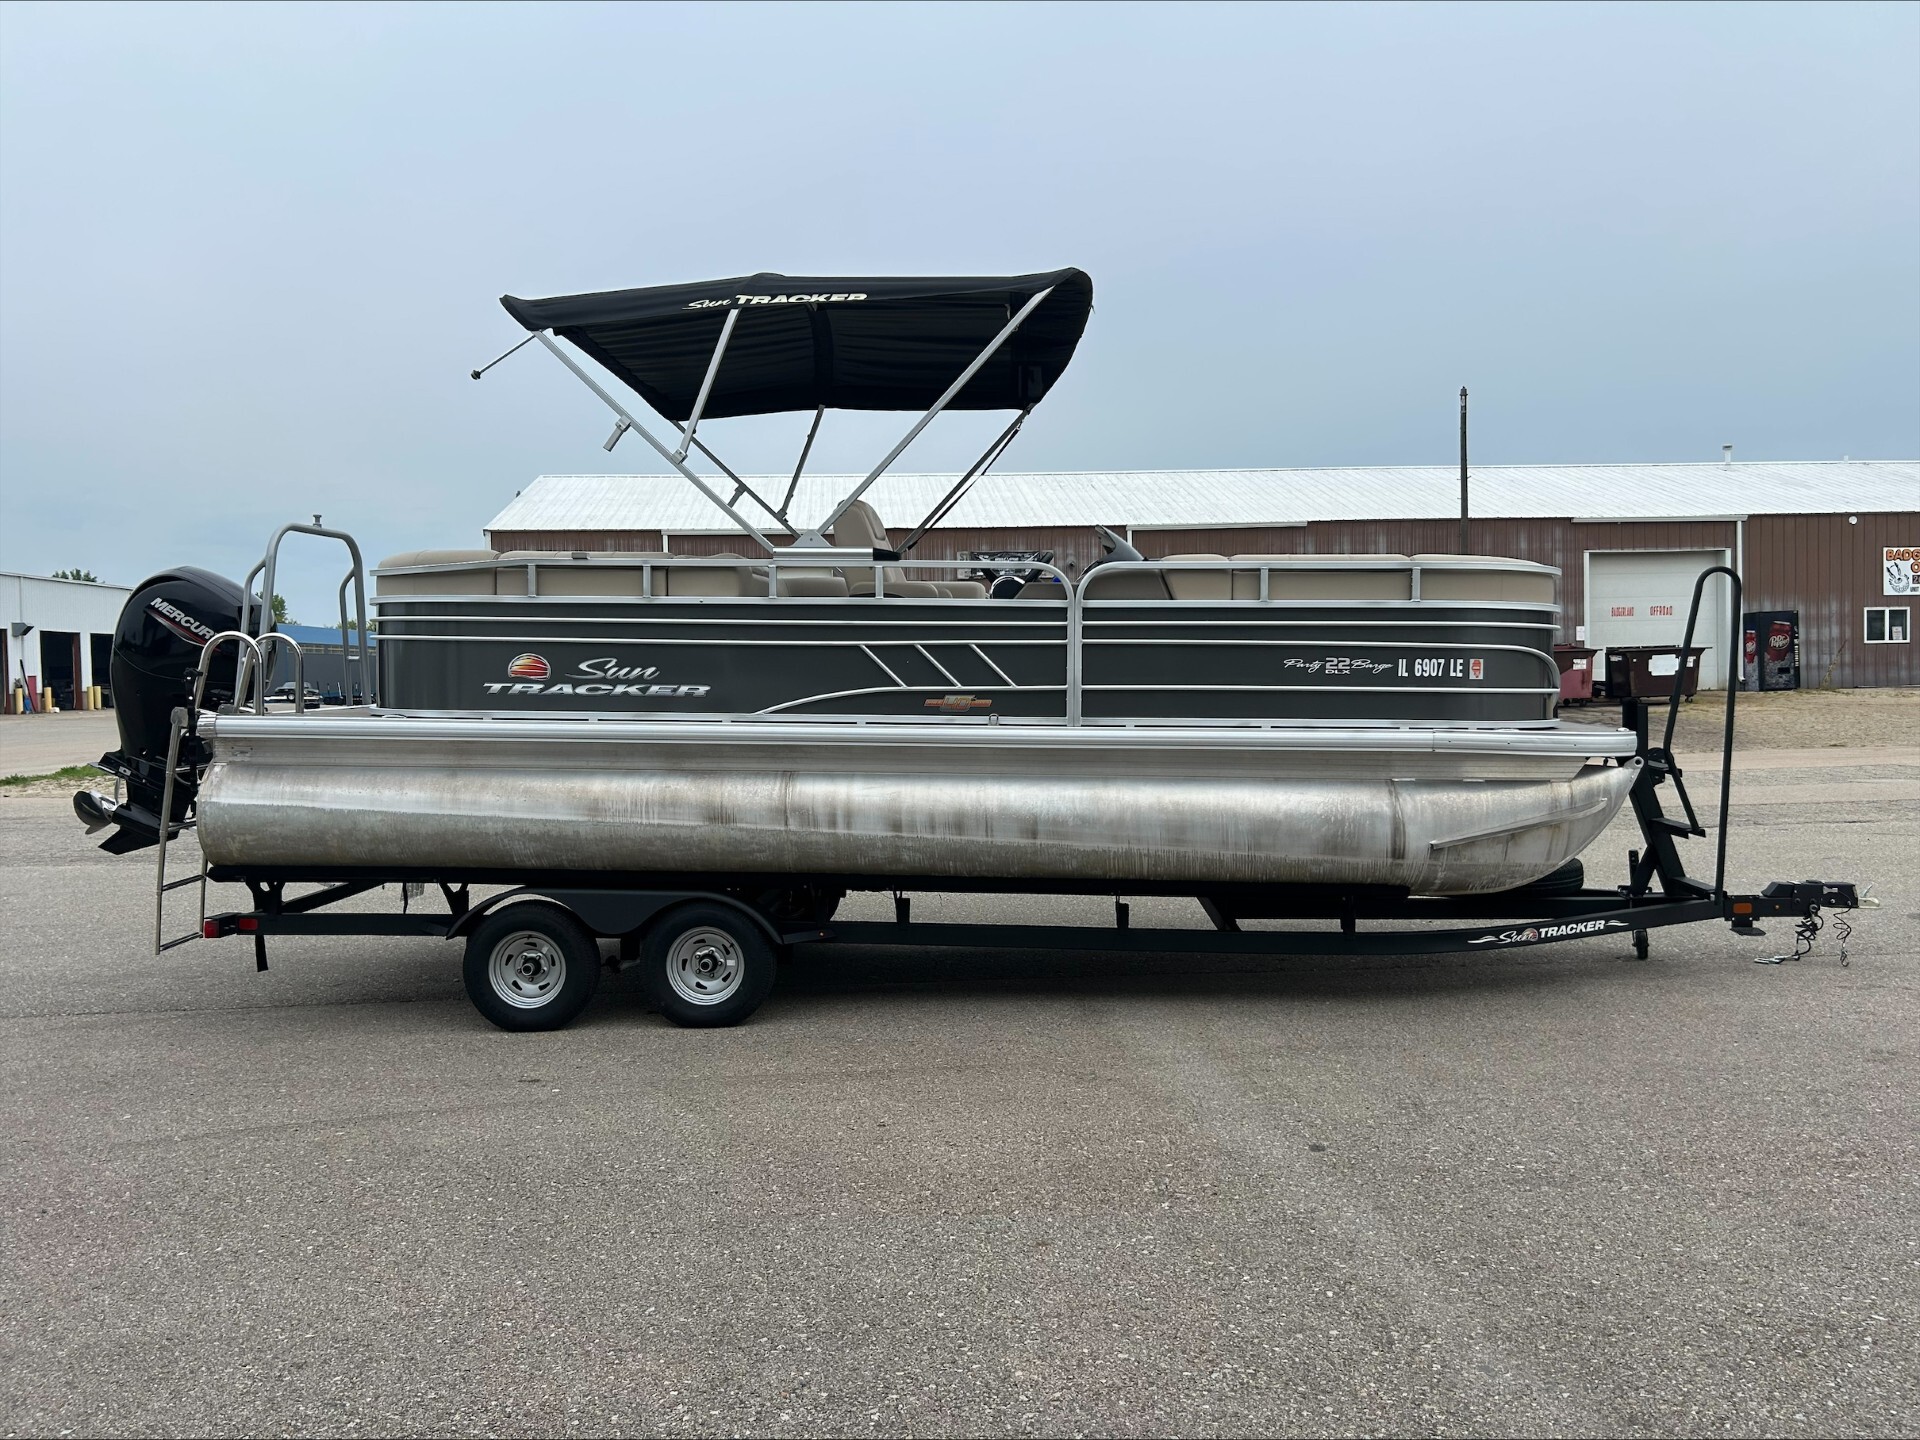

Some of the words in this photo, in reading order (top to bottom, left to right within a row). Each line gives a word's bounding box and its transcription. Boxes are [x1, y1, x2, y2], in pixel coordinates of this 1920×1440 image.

[682, 299, 732, 310] Sun
[735, 293, 868, 305] TRACKER
[150, 597, 218, 640] MERCUR
[1650, 605, 1672, 616] OFFROAD
[564, 657, 661, 680] Sun
[1283, 658, 1325, 674] Party
[1325, 657, 1350, 670] 22
[1350, 659, 1394, 675] Barge
[1398, 658, 1408, 677] IL
[1414, 658, 1445, 677] 6907
[1449, 658, 1464, 677] LE
[483, 682, 711, 697] TRACKER
[1497, 931, 1537, 944] Sun
[1539, 919, 1606, 939] TRACKER
